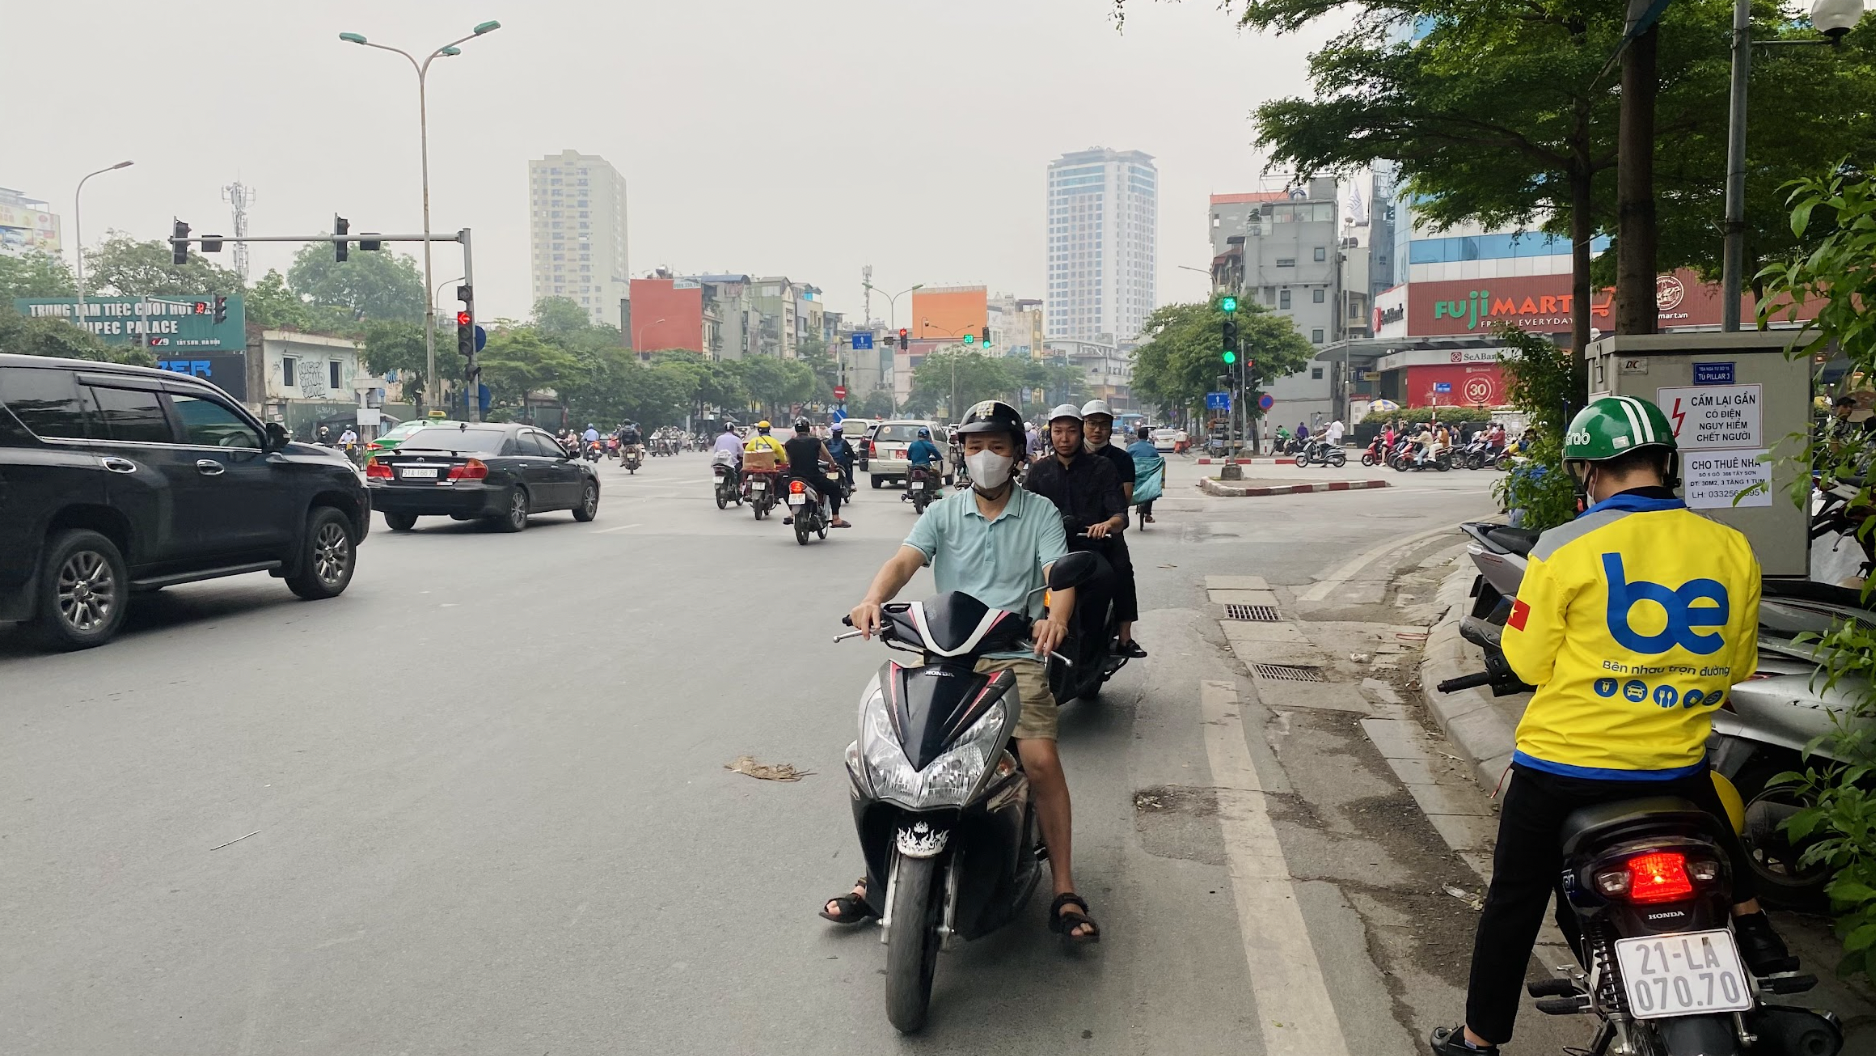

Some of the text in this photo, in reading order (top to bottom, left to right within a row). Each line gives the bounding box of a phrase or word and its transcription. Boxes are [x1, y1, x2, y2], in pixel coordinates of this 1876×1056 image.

[1464, 353, 1497, 361] SeABan
[1469, 383, 1487, 396] 30
[1691, 392, 1713, 407] CẤM
[1716, 395, 1732, 408] LẠI
[1720, 408, 1741, 420] ĐIỆN
[1699, 417, 1748, 430] NGUY HIỂM
[1696, 430, 1751, 442] CHẾT NGƯỜI
[1691, 460, 1712, 470] CHO
[1714, 457, 1739, 470] THUÊ
[1601, 552, 1730, 655] be
[924, 670, 955, 678] HONDA
[1602, 660, 1731, 677] Bên nhau trọn đường
[1648, 911, 1685, 920] HONDA
[1635, 936, 1721, 976] 21-LA
[1635, 971, 1741, 1012] 070.70
